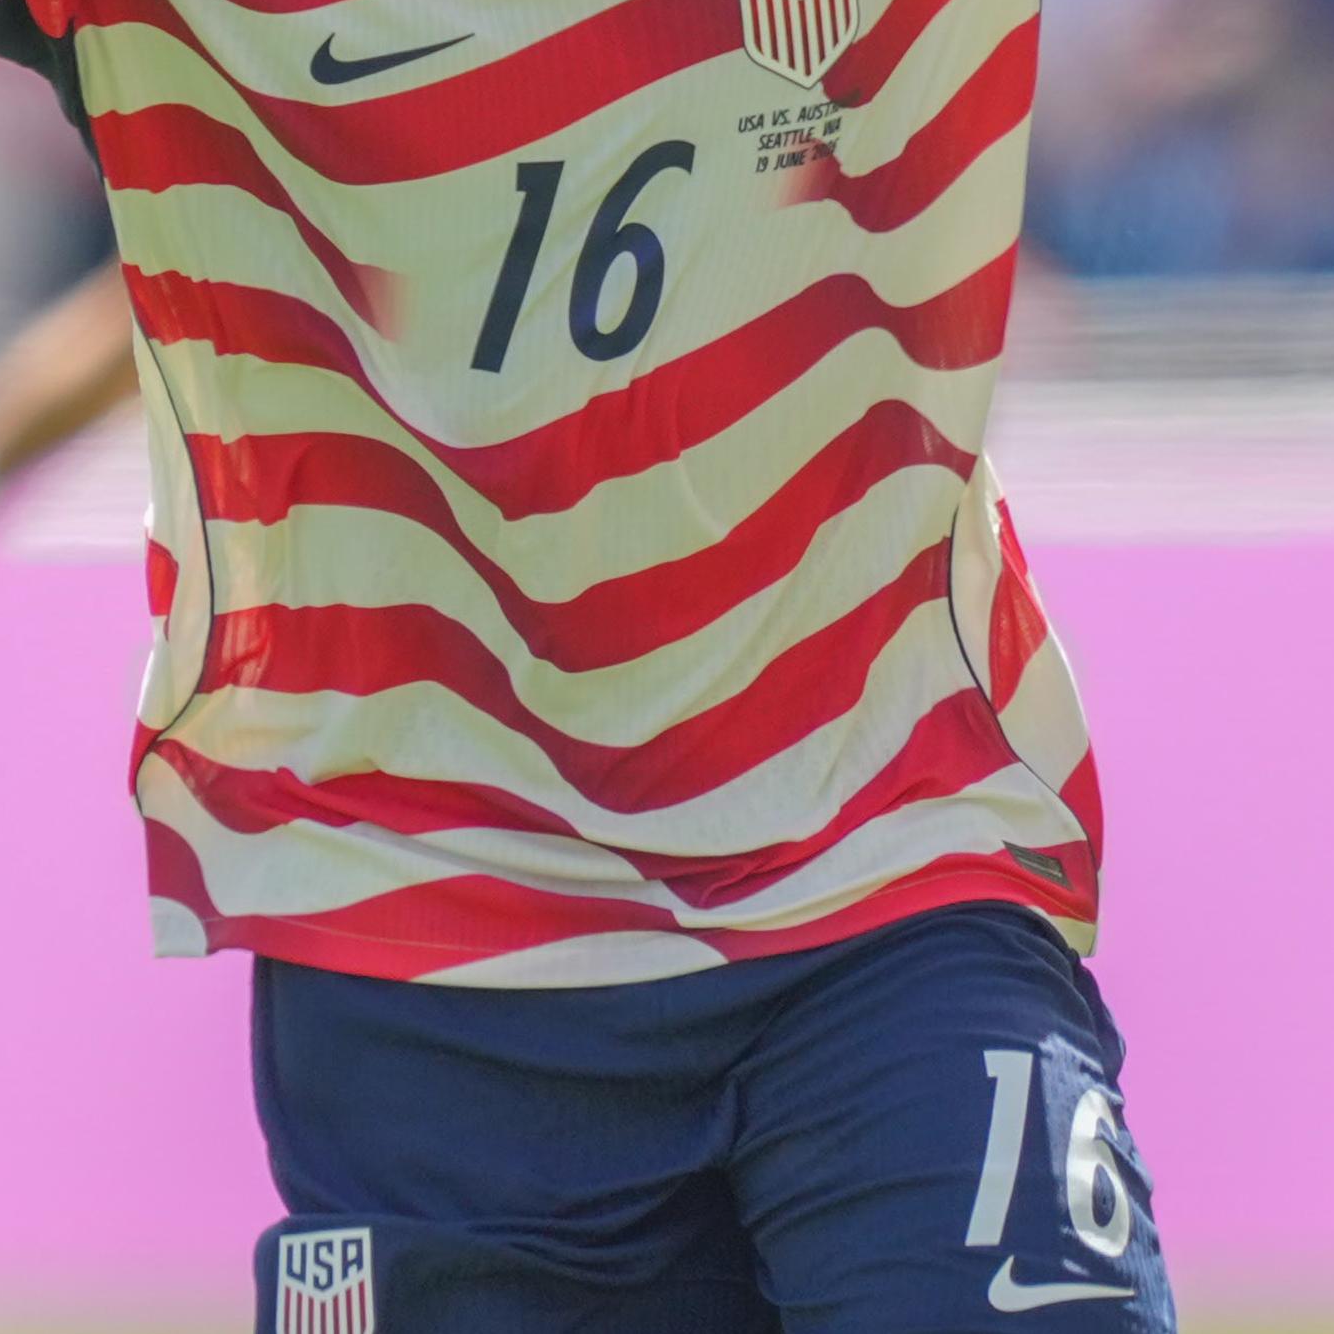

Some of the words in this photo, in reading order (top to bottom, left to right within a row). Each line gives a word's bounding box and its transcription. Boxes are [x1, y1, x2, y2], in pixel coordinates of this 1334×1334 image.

[738, 113, 765, 134] USA
[755, 156, 769, 173] 19
[773, 149, 809, 170] JUNE
[470, 139, 696, 374] 16
[964, 1049, 1131, 1258] 16
[286, 1238, 364, 1292] USA
